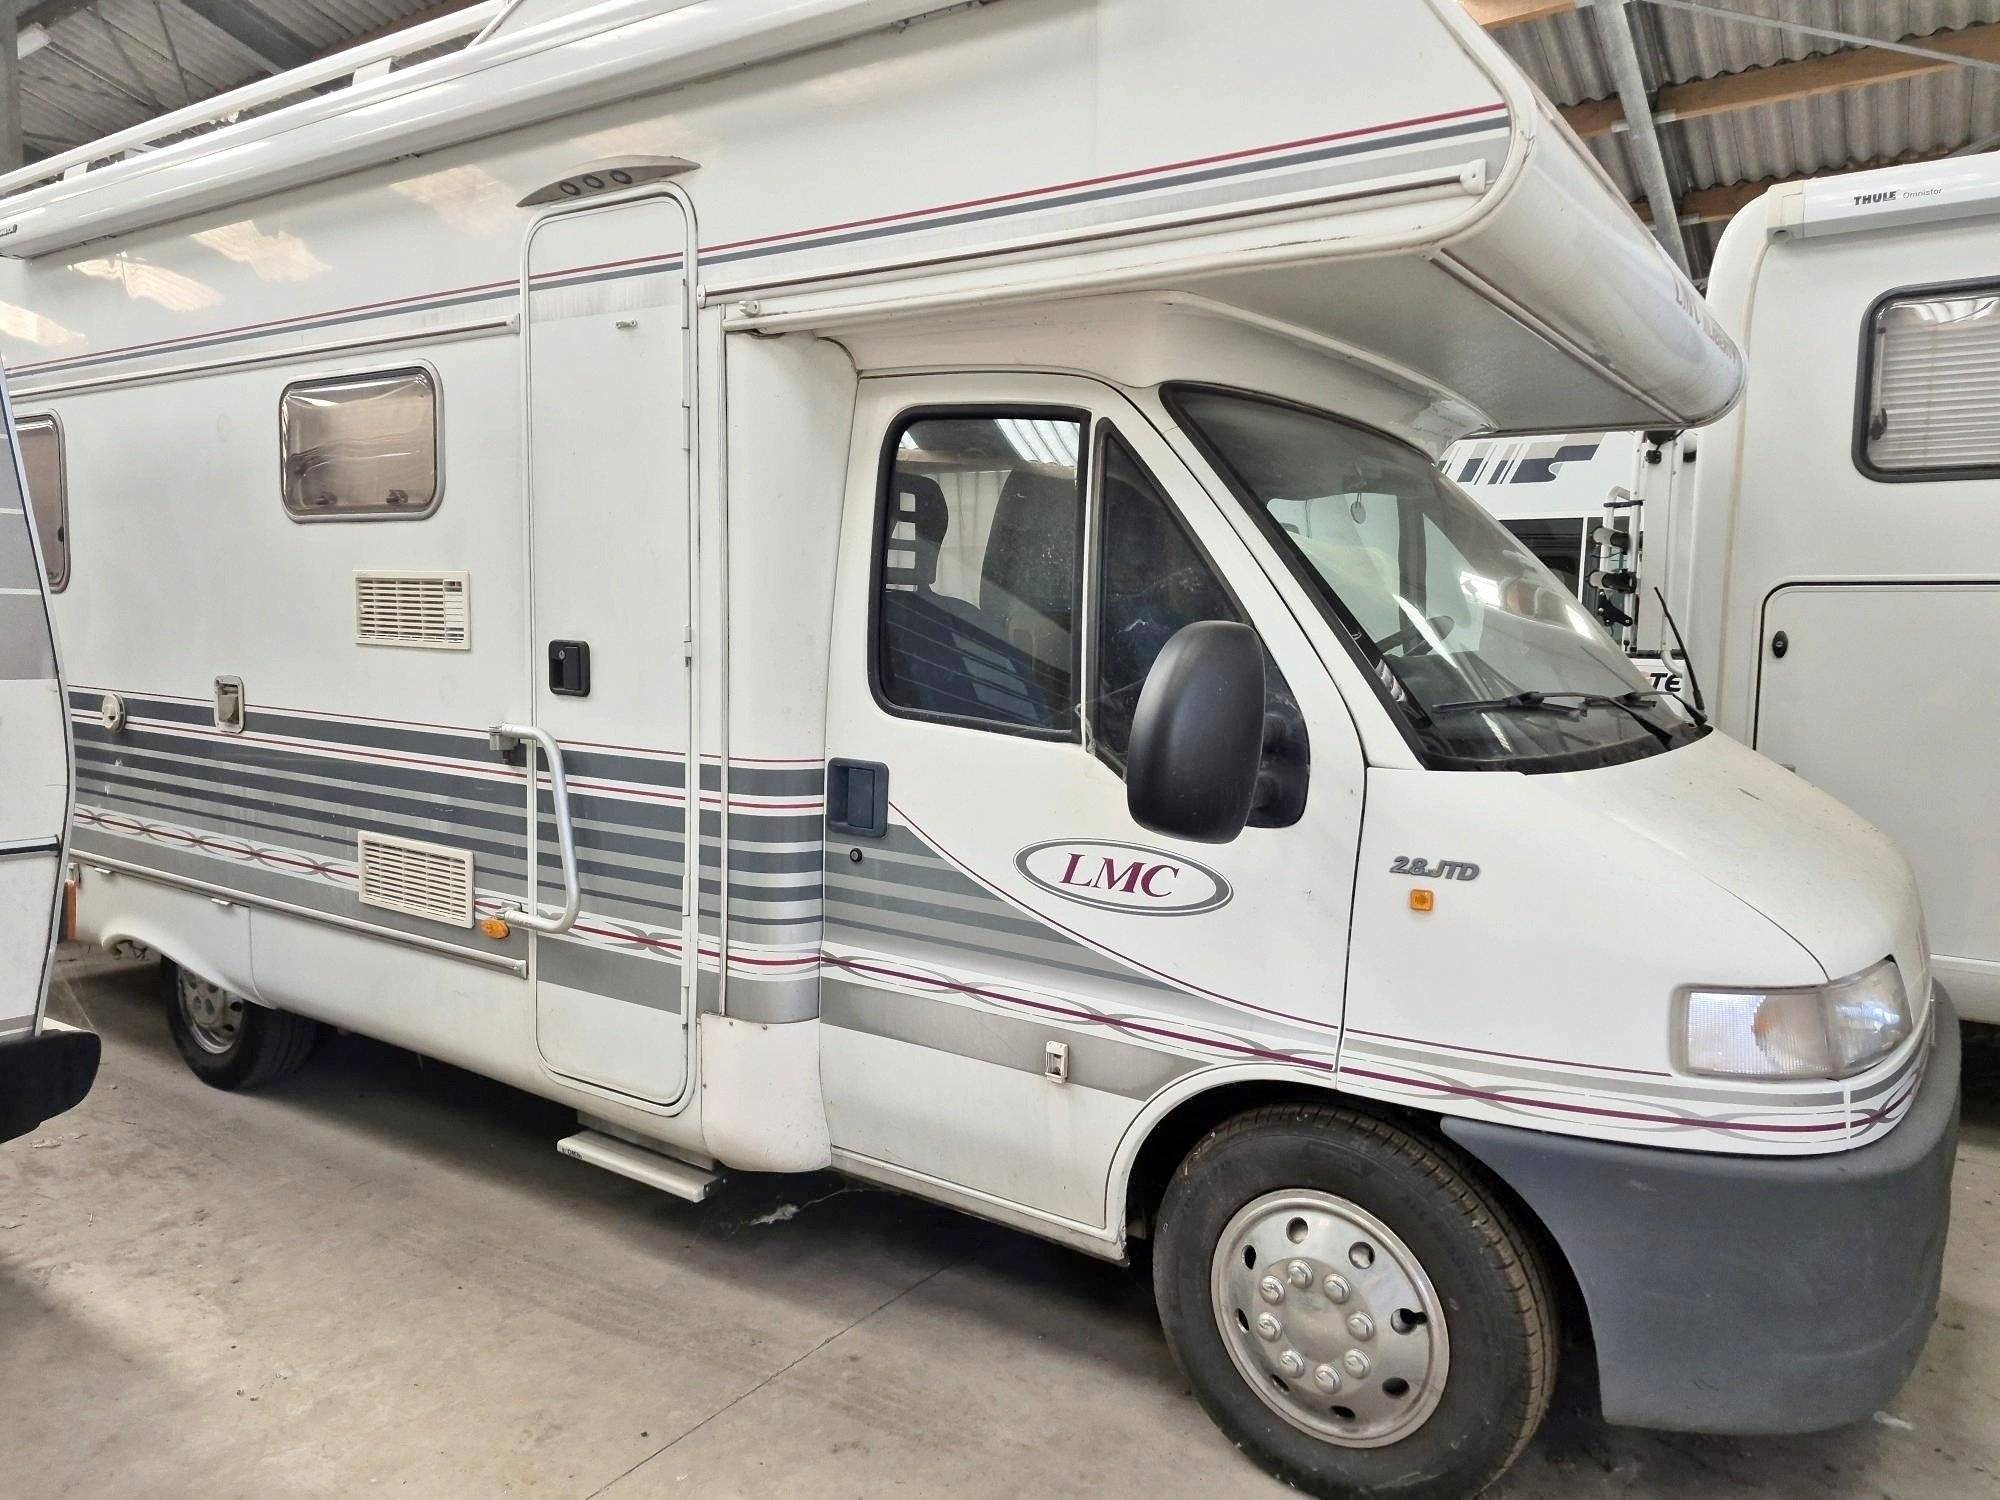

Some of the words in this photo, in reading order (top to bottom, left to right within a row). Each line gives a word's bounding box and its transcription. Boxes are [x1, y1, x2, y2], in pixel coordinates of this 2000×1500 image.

[1854, 190, 1897, 205] THULE
[1902, 187, 1943, 199] Omnistor
[1060, 852, 1180, 898] LMC
